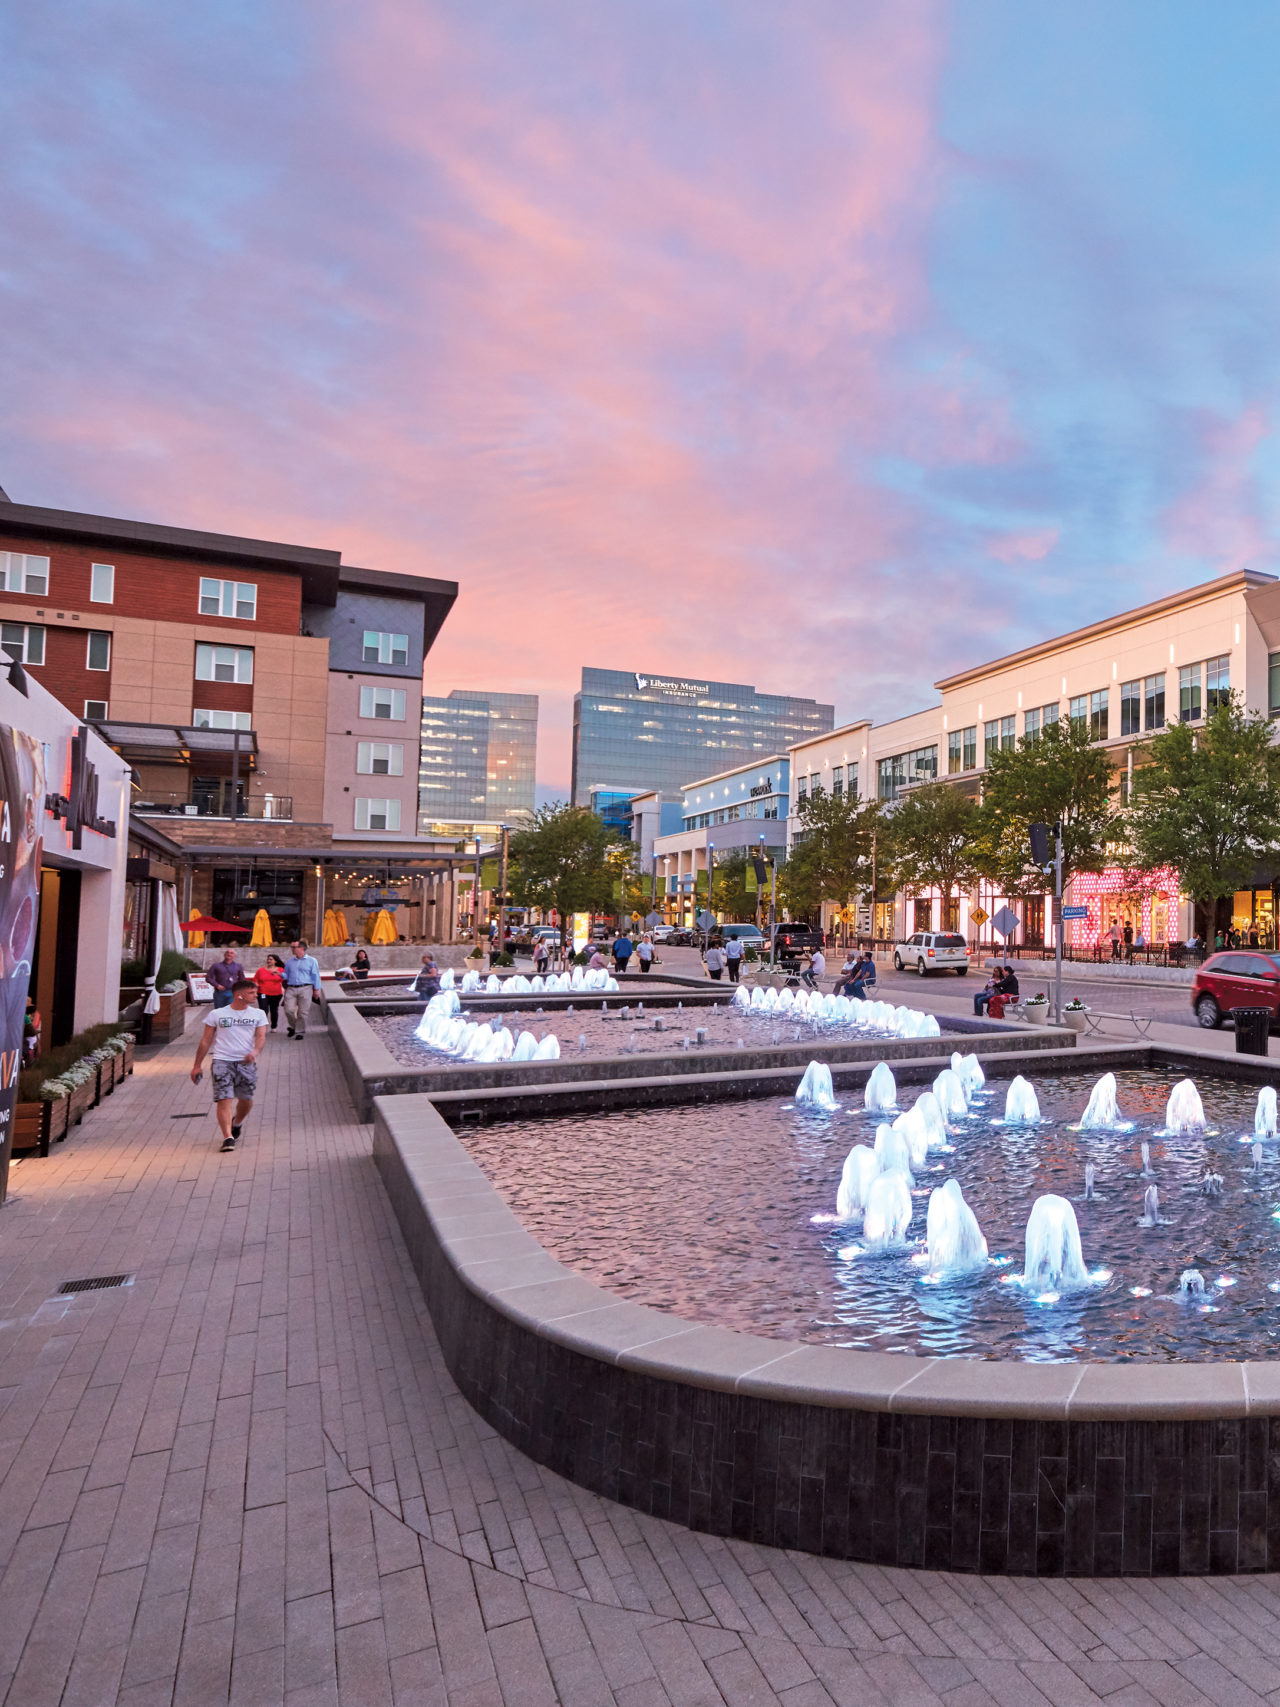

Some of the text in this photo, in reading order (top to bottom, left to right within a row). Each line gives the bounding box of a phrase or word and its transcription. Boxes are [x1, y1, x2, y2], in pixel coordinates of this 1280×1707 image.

[650, 679, 709, 692] Liberty Mutual
[662, 690, 697, 698] INSURANCE
